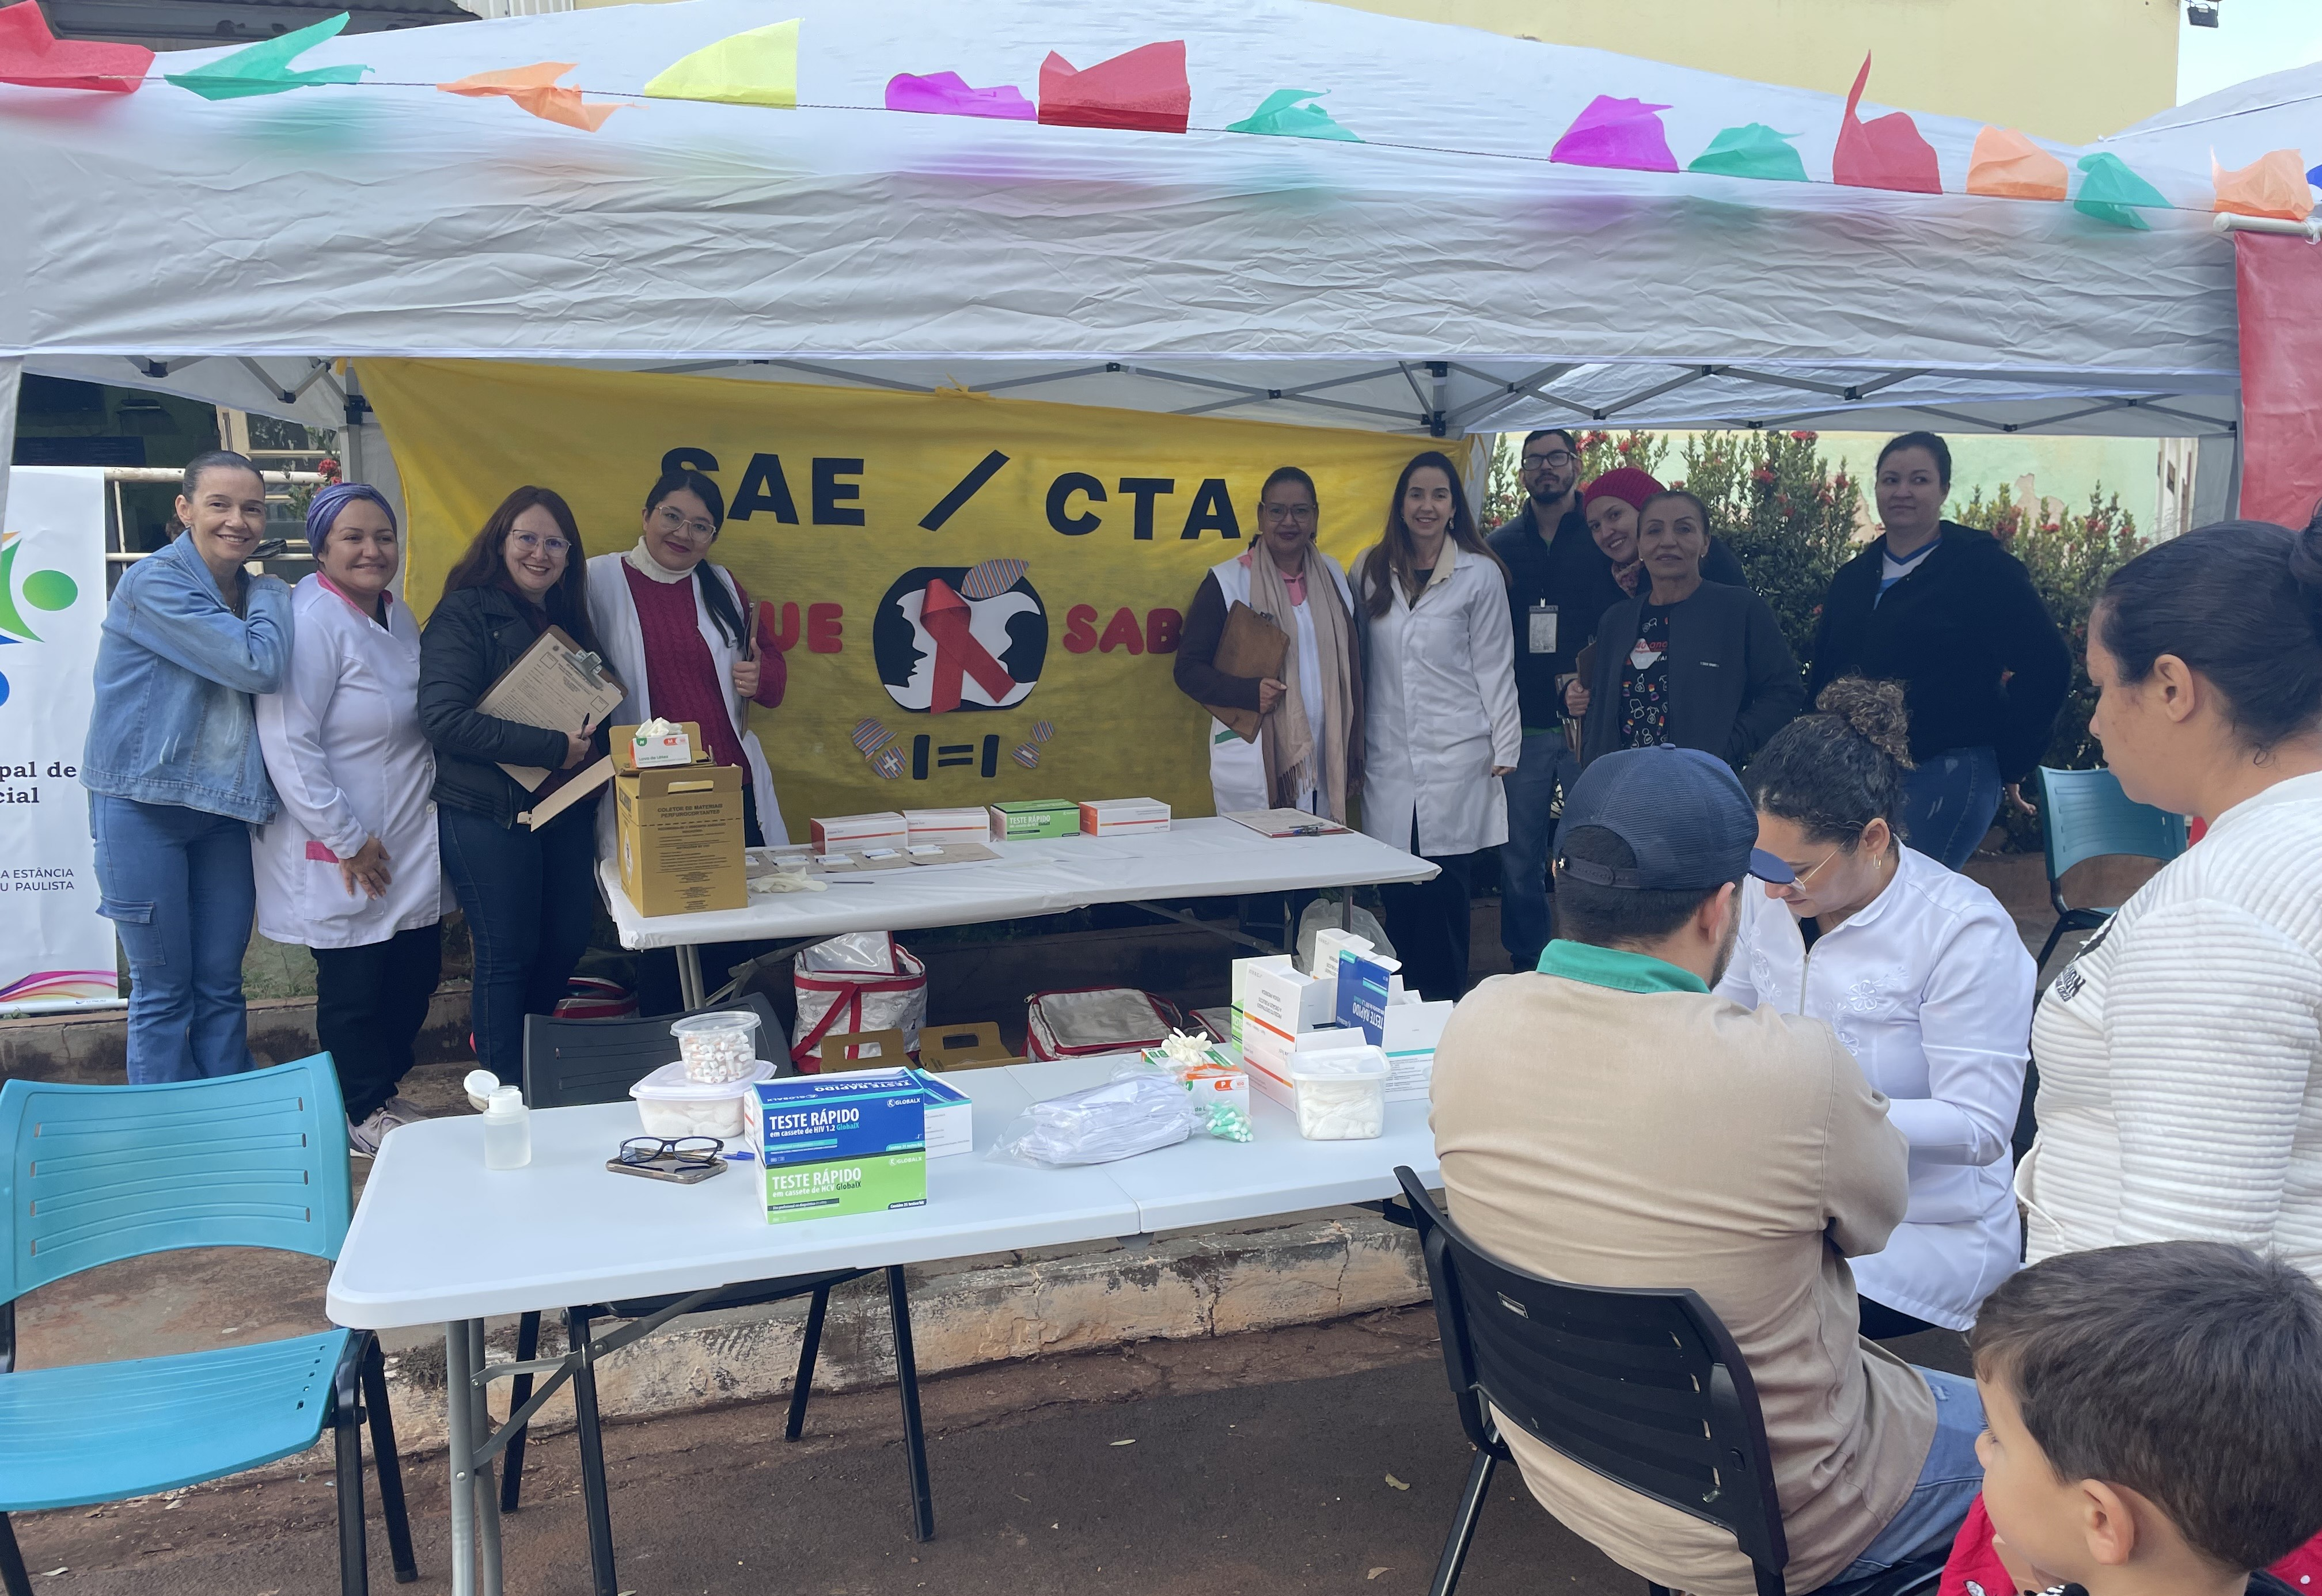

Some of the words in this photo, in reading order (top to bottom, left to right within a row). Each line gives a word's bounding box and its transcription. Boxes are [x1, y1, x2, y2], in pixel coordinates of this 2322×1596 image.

[1045, 472, 1241, 540] CTA
[47, 761, 77, 777] de
[1010, 816, 1027, 824] TESTE
[1028, 814, 1051, 824] RÁPIDO
[13, 867, 74, 879] ESTÂNCIA
[16, 881, 74, 891] PAULISTA
[1369, 1012, 1383, 1030] TESTE
[769, 1113, 807, 1130] TESTE
[810, 1108, 860, 1126] RÁPIDO
[781, 1128, 804, 1137] cassete
[814, 1125, 825, 1134] HIV
[836, 1122, 860, 1131] GlobalX
[772, 1173, 810, 1190] TESTE
[813, 1167, 862, 1186] RÁPIDO
[785, 1188, 810, 1196] cassete
[821, 1184, 835, 1192] HCV
[836, 1181, 862, 1191] GlobalX
